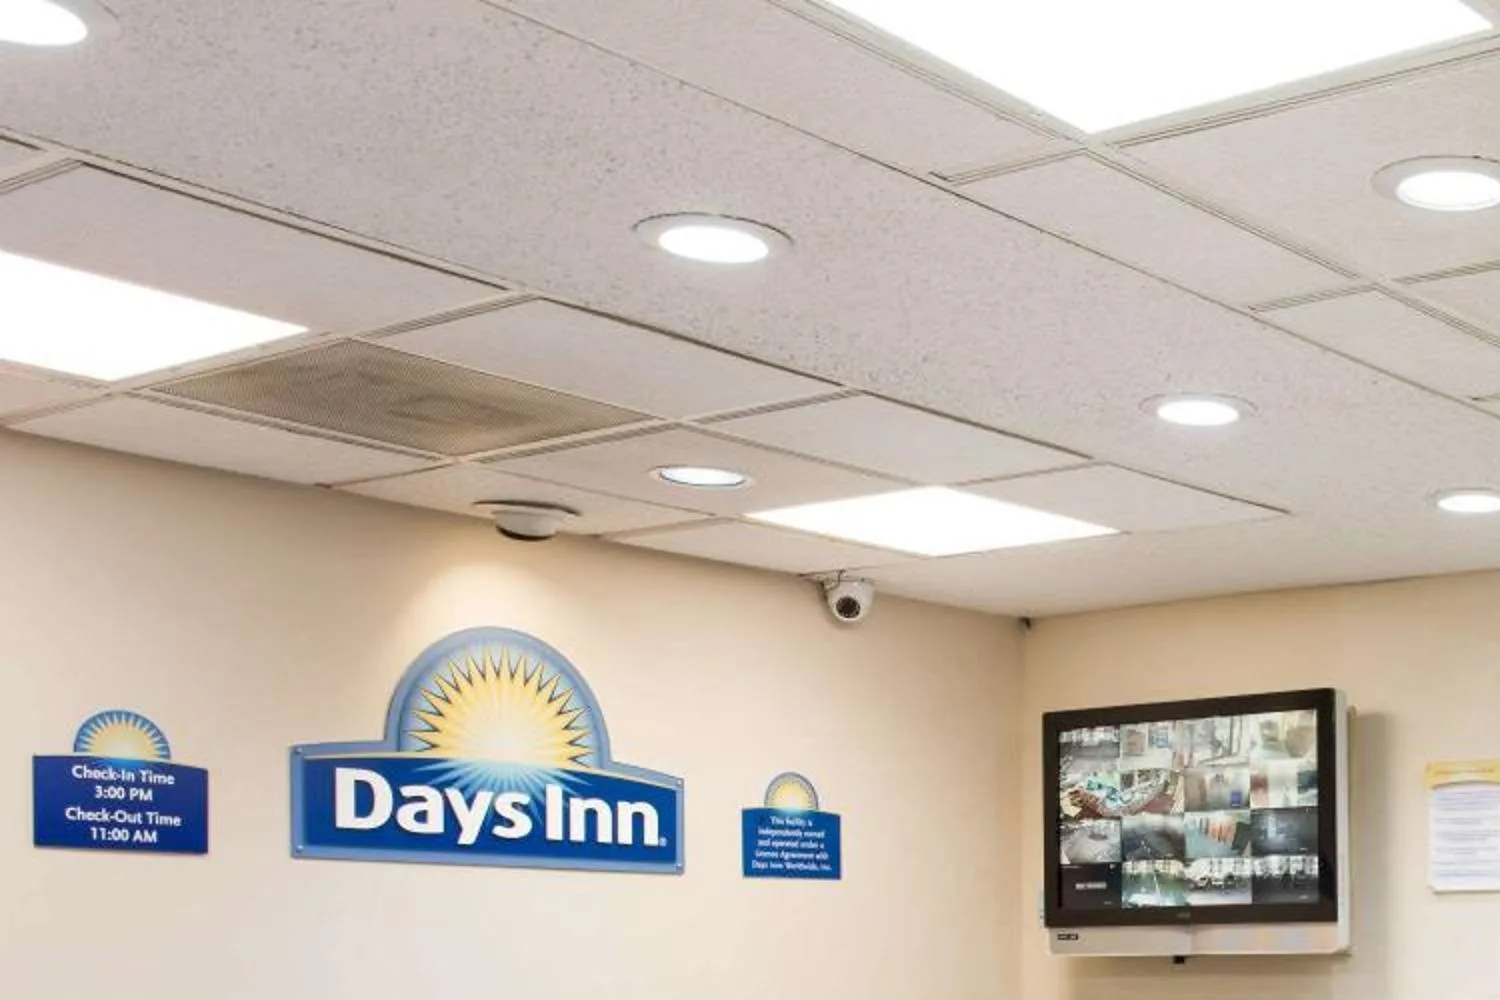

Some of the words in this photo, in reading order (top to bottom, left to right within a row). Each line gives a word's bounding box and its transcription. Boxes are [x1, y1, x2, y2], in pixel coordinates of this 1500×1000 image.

[71, 765, 135, 782] Check-In
[140, 769, 175, 785] Time
[95, 785, 125, 800] 3:00
[129, 787, 153, 802] PM
[65, 807, 142, 824] Check-Out
[146, 811, 182, 827] Time
[335, 767, 532, 846] Days
[545, 784, 660, 847] Inn
[90, 827, 129, 841] 11:00
[132, 829, 158, 843] AM
